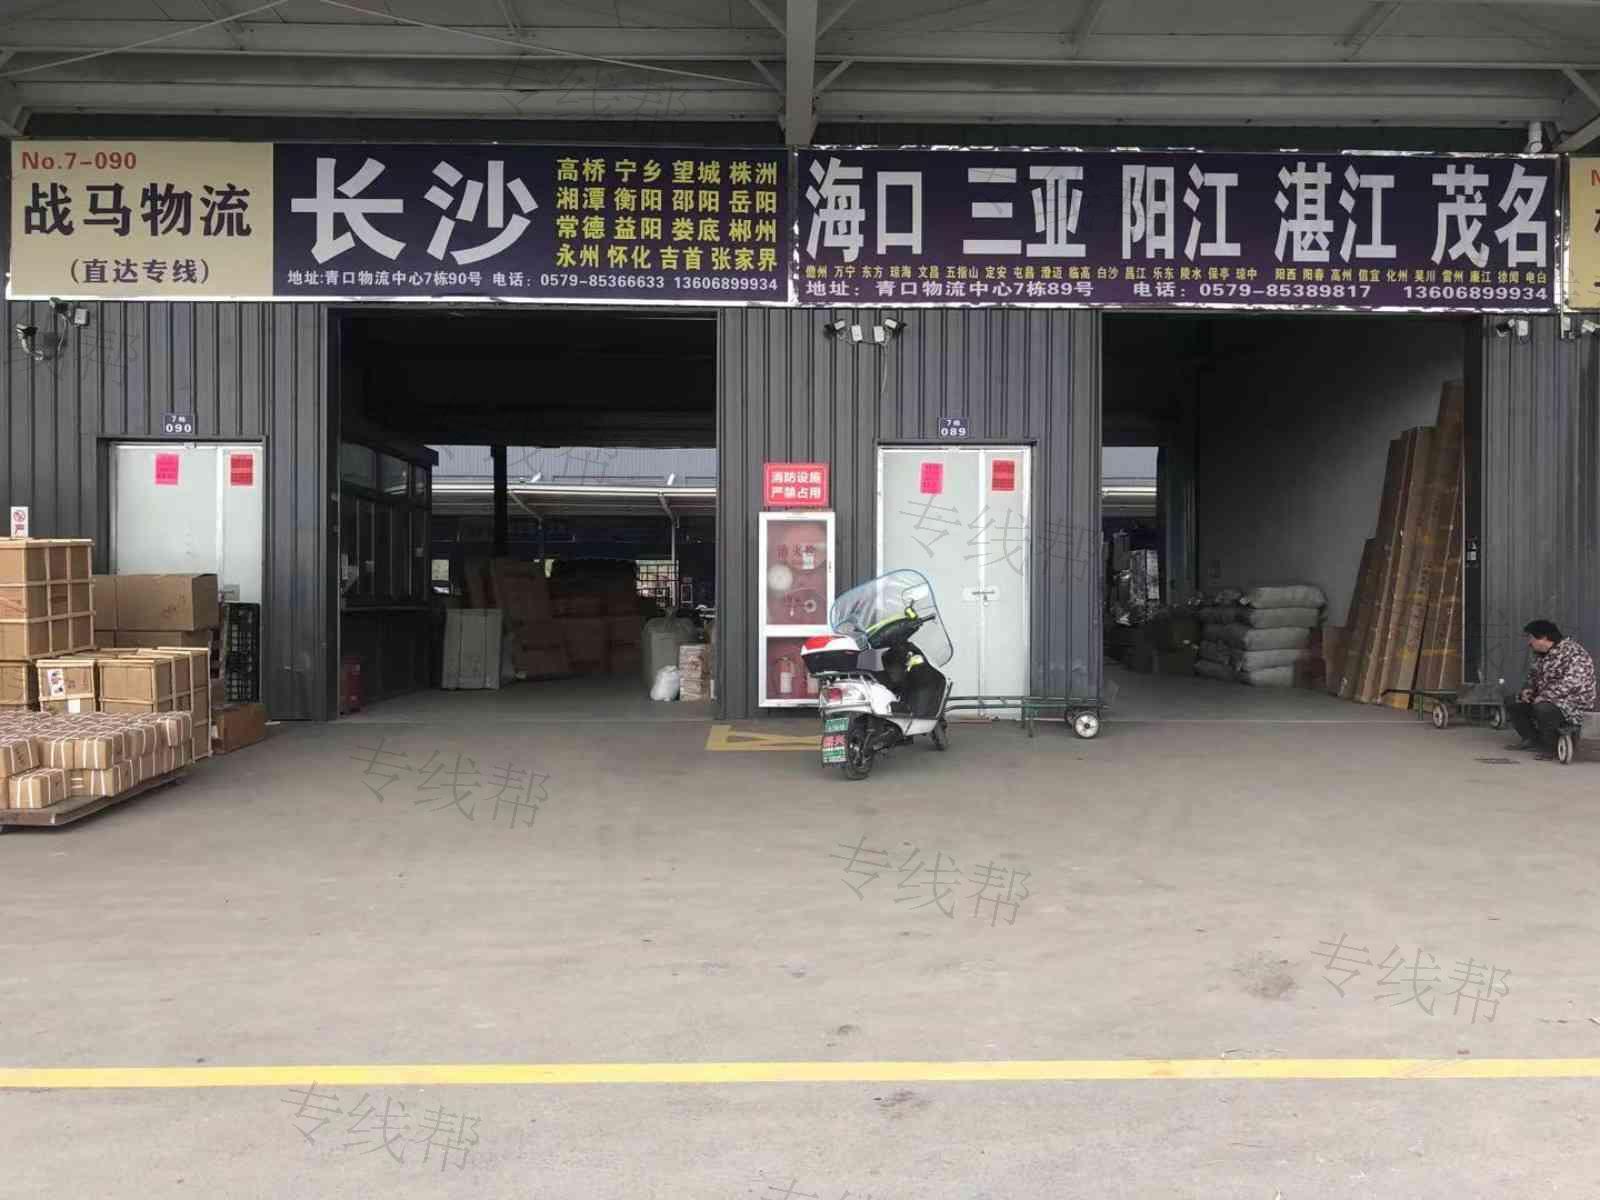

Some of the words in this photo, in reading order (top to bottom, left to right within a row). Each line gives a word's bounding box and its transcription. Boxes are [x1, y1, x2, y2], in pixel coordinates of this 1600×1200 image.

[22, 151, 137, 170] No.7-090
[556, 157, 606, 183] 高桥
[614, 158, 662, 183] 宁乡
[671, 159, 721, 185] 望城
[728, 160, 777, 186] 株洲
[24, 182, 252, 237] 战马物流
[290, 157, 539, 266] 长沙
[556, 186, 606, 211] 湘潭
[613, 187, 662, 212] 衡阳
[671, 189, 720, 213] 邵阳
[728, 189, 777, 214] 岳阳
[805, 156, 923, 263] 海口
[962, 165, 1087, 258] 三亚
[1121, 163, 1241, 262] 阳江
[1274, 161, 1397, 263] 湛江
[1430, 163, 1548, 268] 茂名
[556, 214, 606, 240] 常德
[613, 215, 662, 240] 益阳
[671, 217, 721, 242] 娄底
[728, 218, 777, 243] 郴州
[70, 257, 209, 284] （直达专线）
[556, 243, 599, 269] 永州
[607, 244, 652, 269] 怀化
[659, 245, 704, 271] 吉首
[711, 246, 778, 273] 张家界
[287, 269, 482, 288] 地址:青口物流中心7栋90号
[673, 276, 778, 291] 13606899934
[834, 266, 856, 280] 万宁
[862, 266, 884, 280] 东方
[917, 266, 939, 280] 文昌
[984, 267, 1007, 281] 定安
[1097, 268, 1119, 282] 白沙
[1124, 268, 1147, 282] 昌江
[1152, 268, 1175, 282] 乐东
[1275, 269, 1297, 283] 阳西
[1330, 269, 1353, 283] 高州
[1386, 270, 1408, 284] 化州
[1414, 270, 1436, 284] 吴川
[1525, 271, 1547, 285] 电白
[1403, 285, 1548, 300] 13606899934
[165, 423, 192, 434] 090
[939, 426, 967, 437] 089
